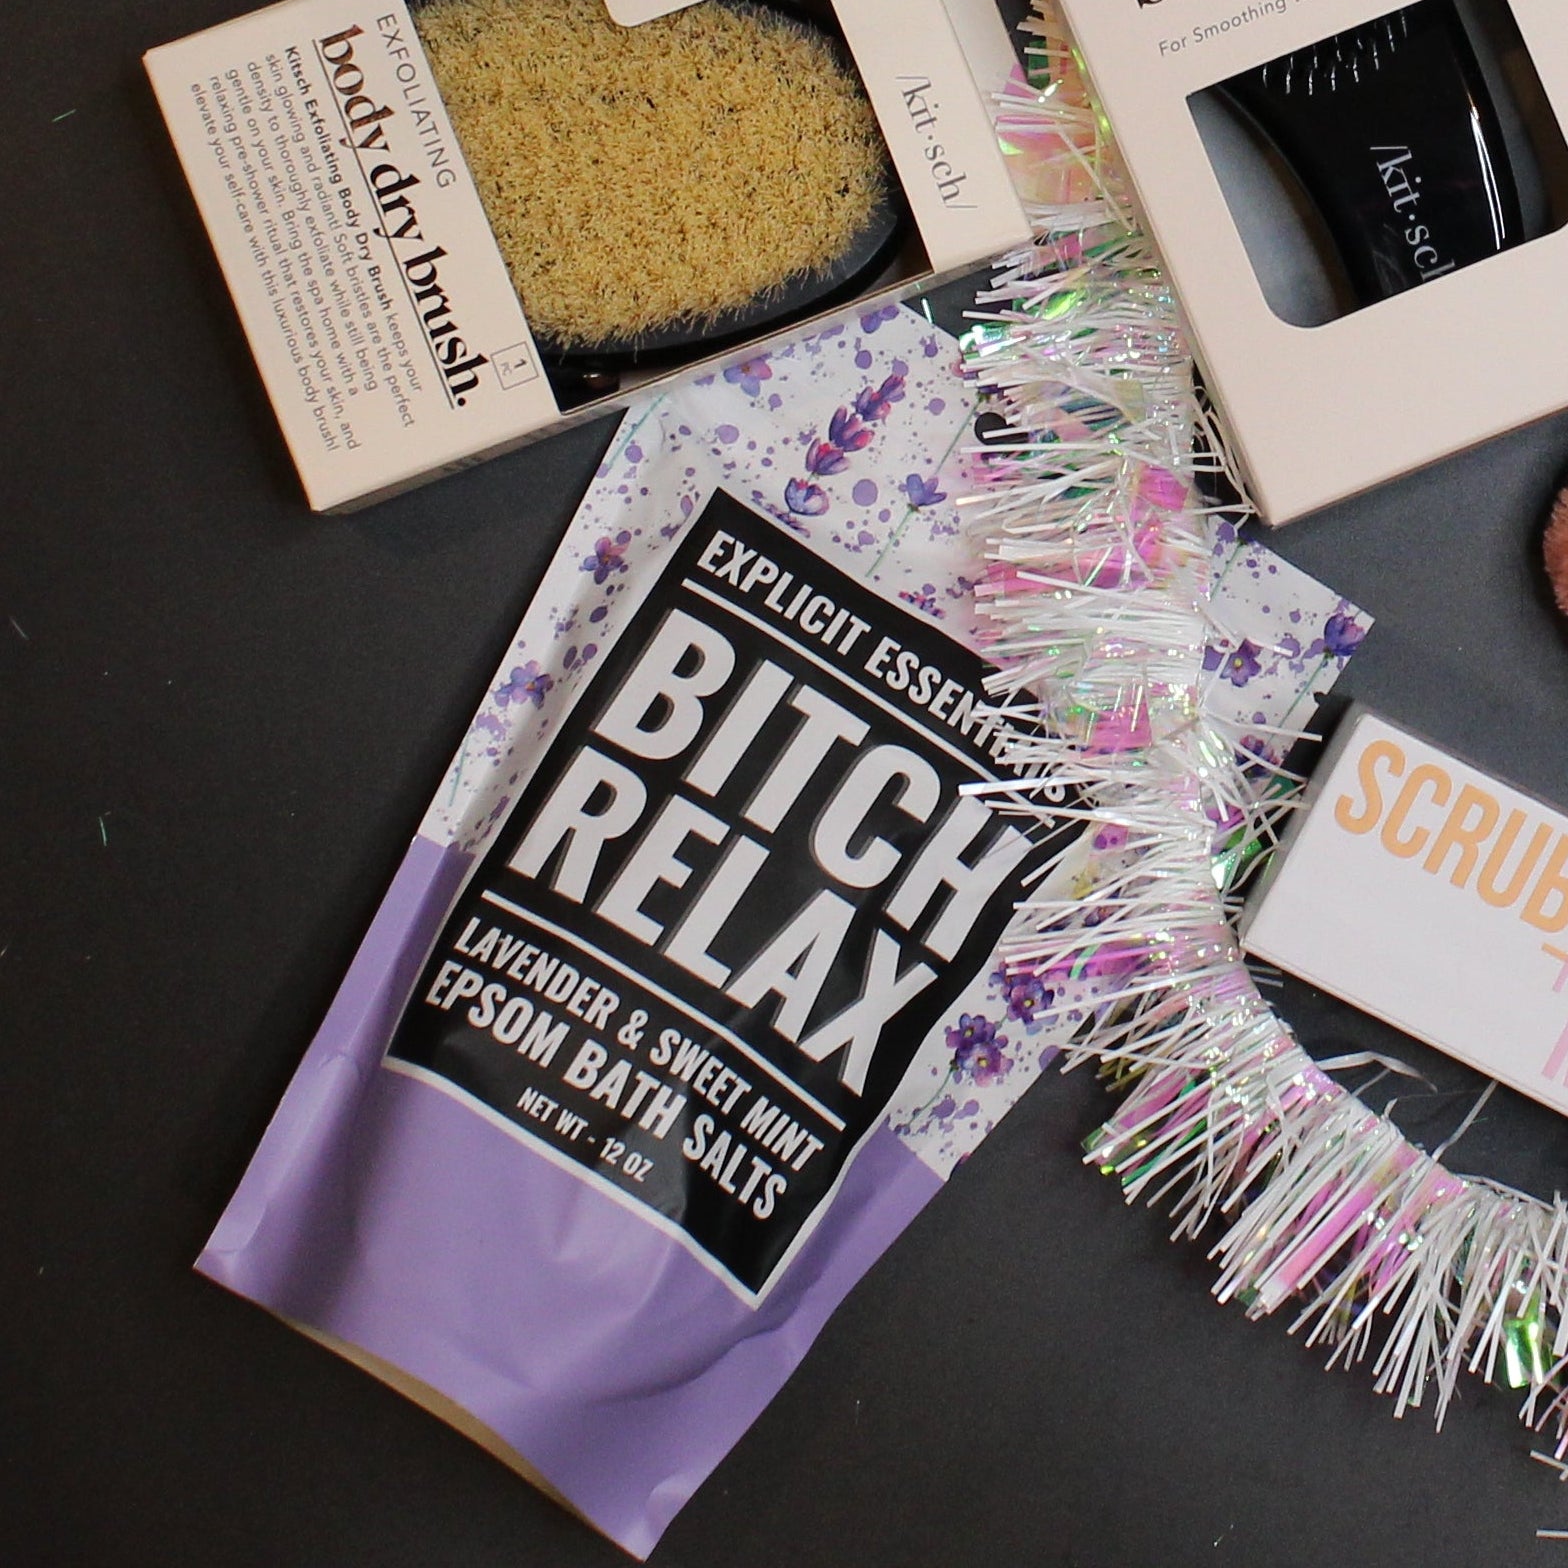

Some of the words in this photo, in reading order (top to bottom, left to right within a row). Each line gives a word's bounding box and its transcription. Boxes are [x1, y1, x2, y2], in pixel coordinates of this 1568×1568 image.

[377, 14, 456, 188] EXFOLIATING
[1158, 36, 1187, 57] For
[285, 46, 311, 95] Kitsch
[305, 99, 342, 184] Exfoliating
[337, 187, 361, 228] Body
[355, 231, 373, 261] Dry
[367, 265, 393, 311] Brush
[385, 312, 409, 358] keeps
[399, 359, 423, 391] your
[313, 25, 394, 160] body
[361, 164, 423, 252] dry
[403, 246, 488, 406] brush.
[513, 358, 527, 369] 1
[697, 530, 871, 655] EXPLICIT
[594, 608, 1035, 962] BITCH
[454, 917, 620, 1030] LAVENDER
[618, 1010, 648, 1050] &
[650, 1029, 752, 1114] SWEET
[740, 1096, 824, 1171] MINT
[508, 746, 938, 1096] RELAX
[426, 960, 570, 1068] EPSOM
[563, 1039, 687, 1139] BATH
[680, 1114, 787, 1219] SALTS
[517, 1087, 558, 1121] NET
[555, 1109, 588, 1140] WT
[599, 1137, 626, 1166] 12
[623, 1152, 653, 1182] OZ
